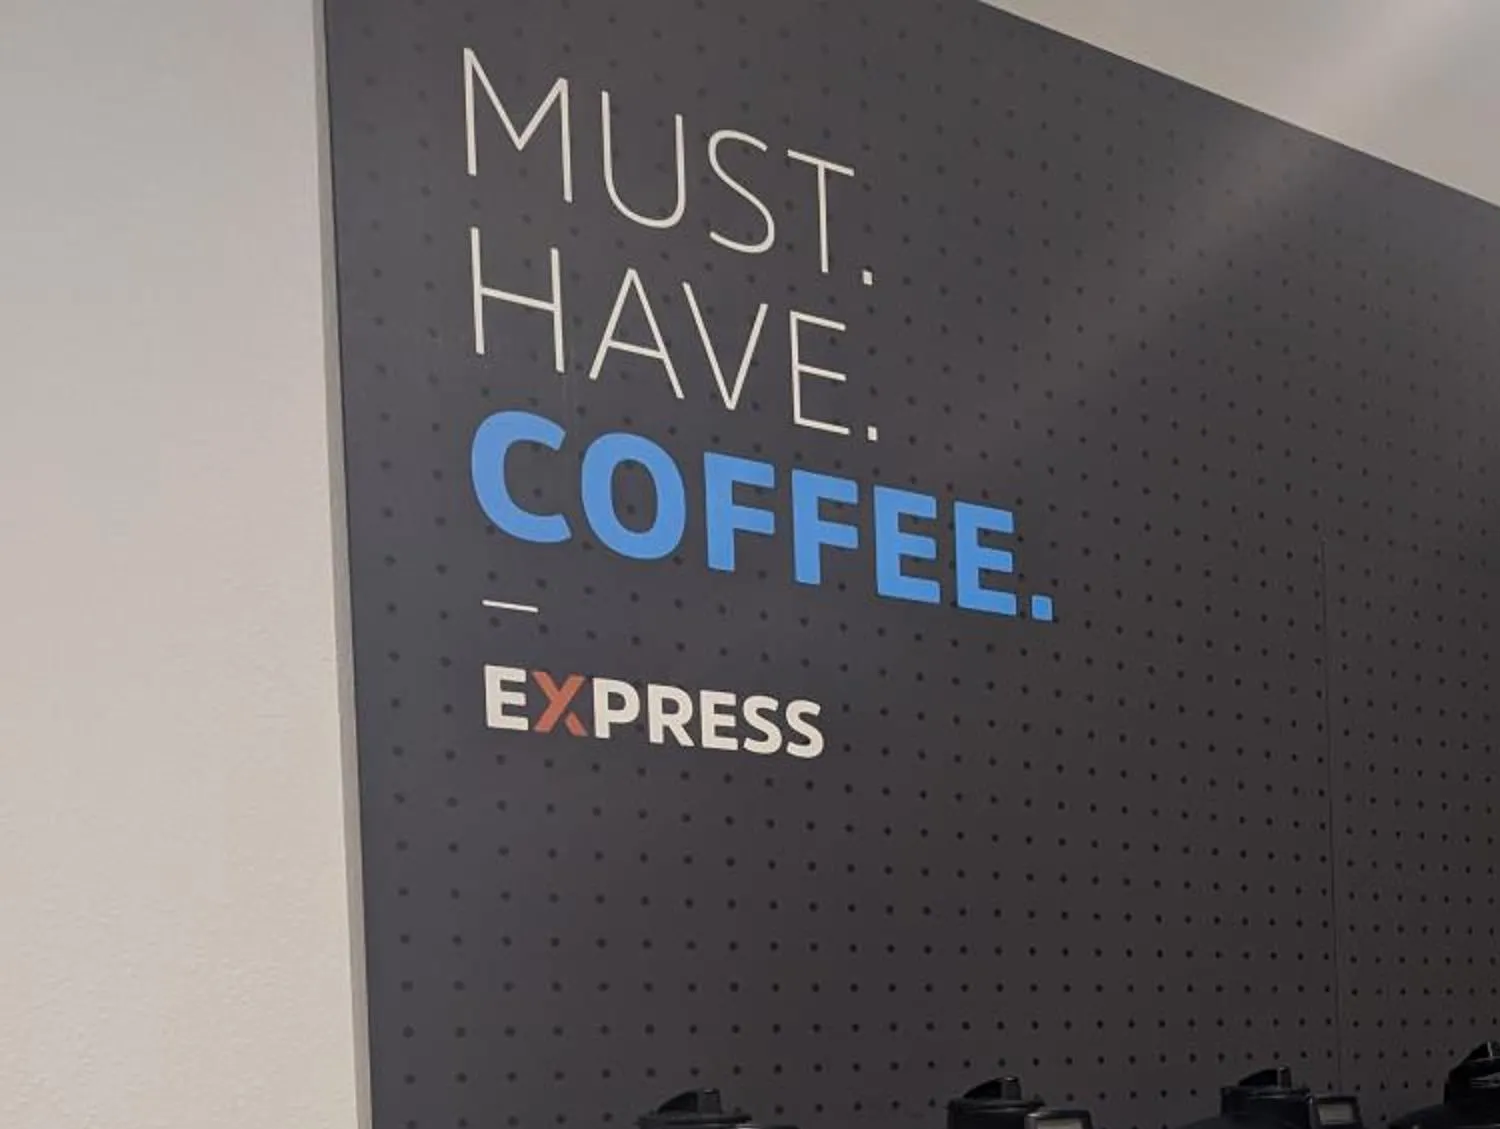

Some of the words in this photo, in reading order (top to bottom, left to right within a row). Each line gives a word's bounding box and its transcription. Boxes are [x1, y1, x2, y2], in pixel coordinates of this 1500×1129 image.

[464, 47, 873, 285] MUST.
[470, 227, 878, 441] HAVE.
[470, 410, 1054, 621] COFFEE.
[483, 664, 825, 759] EXPRESS
